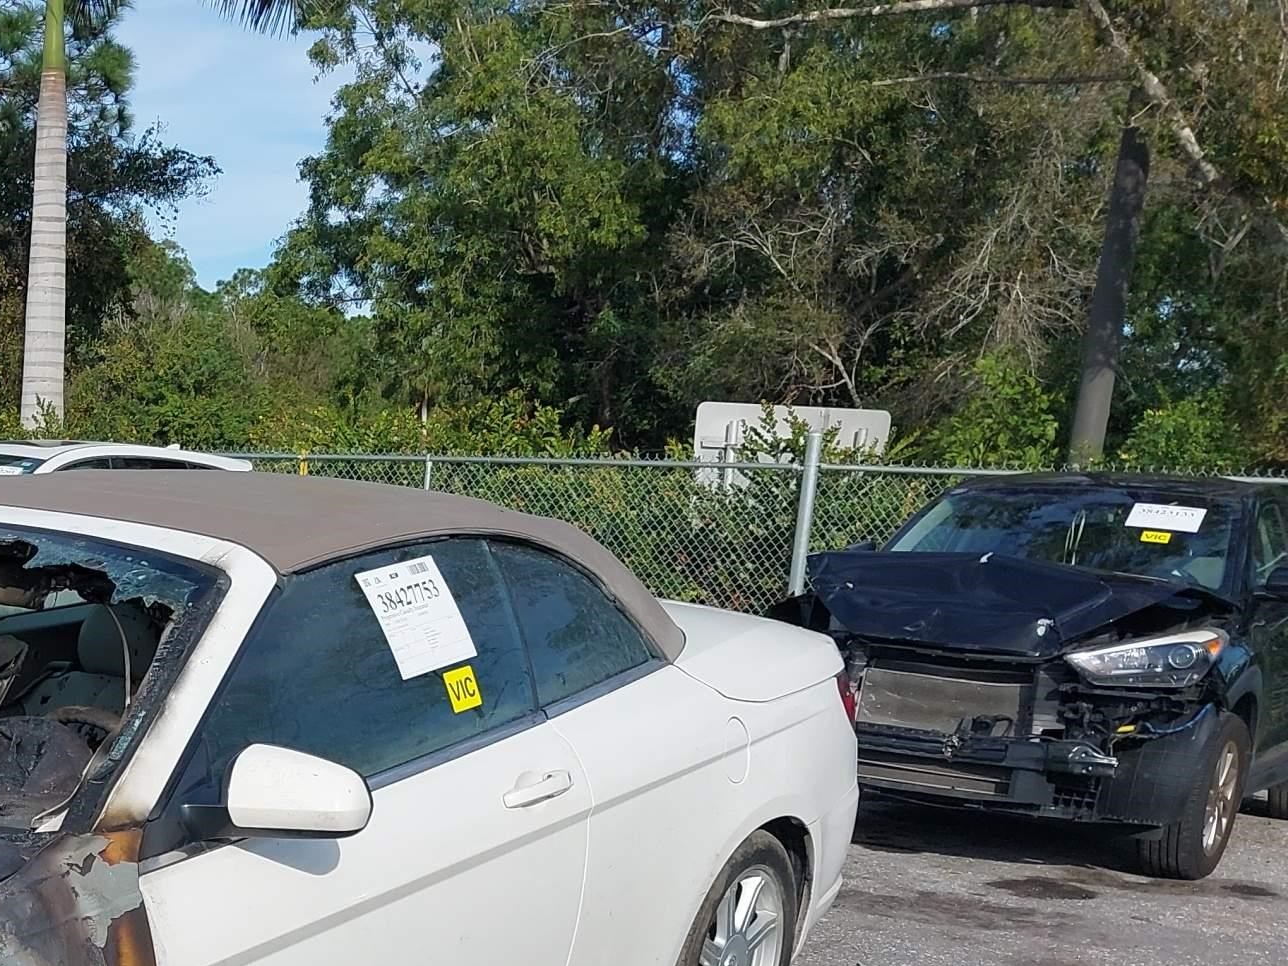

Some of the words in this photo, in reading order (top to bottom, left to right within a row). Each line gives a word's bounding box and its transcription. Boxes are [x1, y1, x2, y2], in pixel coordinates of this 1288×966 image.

[1145, 533, 1167, 541] VIC
[377, 579, 440, 613] 38427753
[449, 677, 476, 702] VIC
